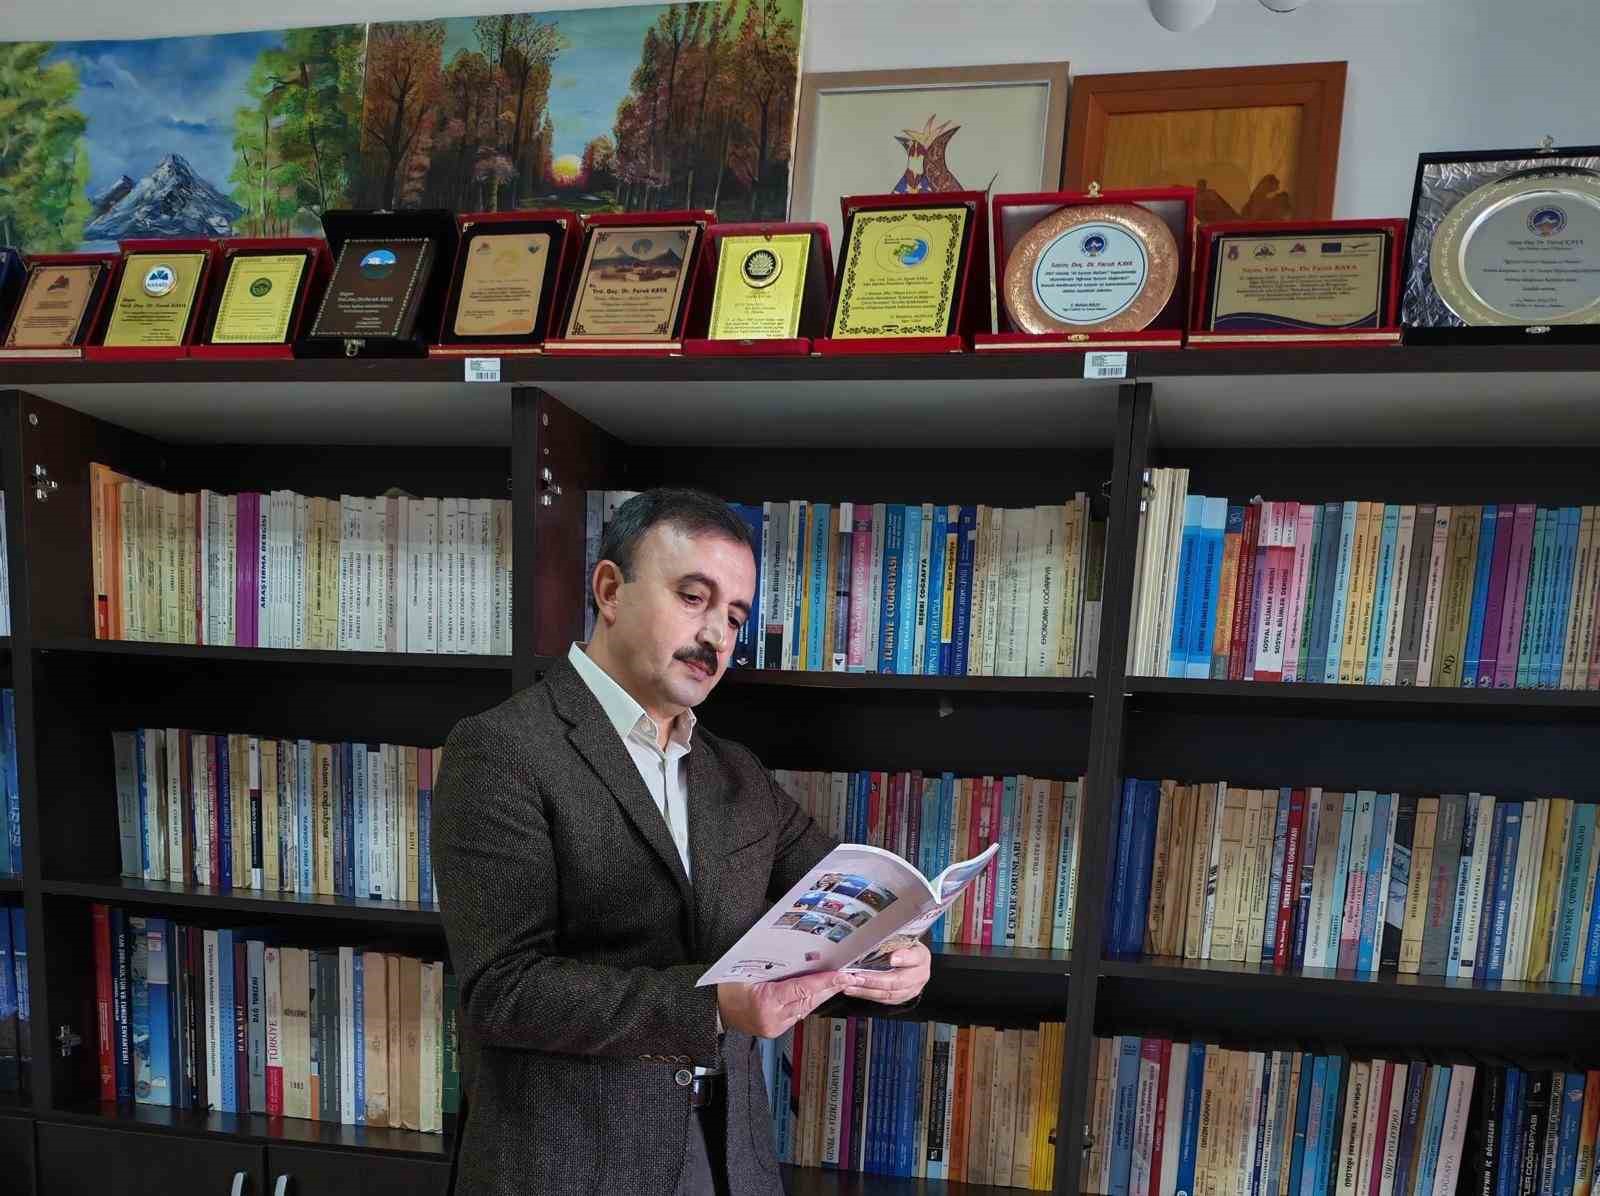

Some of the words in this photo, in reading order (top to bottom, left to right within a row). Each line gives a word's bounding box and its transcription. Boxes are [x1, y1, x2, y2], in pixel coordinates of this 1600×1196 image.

[885, 556, 898, 616] COĞRAFYASI
[919, 558, 928, 598] COĞRAFYA
[1266, 568, 1276, 594] DERGİSİ
[1279, 568, 1288, 596] DERGİSİ
[918, 601, 926, 625] BEŞERİ
[1264, 596, 1273, 626] BİLİMLER
[1276, 598, 1286, 627] BİLİMLER
[883, 622, 894, 660] TÜRKİYE
[1262, 629, 1271, 652] SOSYAL
[1274, 630, 1283, 654] SOSYAL
[1009, 841, 1021, 894] SORUNLARI
[1456, 860, 1468, 896] Bölgeleri
[1007, 896, 1018, 928] ÇEVRE
[1453, 898, 1464, 933] Marmara
[1450, 946, 1460, 960] Ege
[1452, 934, 1461, 944] ve
[252, 1008, 260, 1023] DAĞ
[268, 1020, 278, 1060] TÜRKİYE
[1351, 1083, 1362, 1118] COĞRAFYA
[826, 1136, 837, 1160] GENEL
[1526, 1115, 1538, 1175] COĞRAFYASI
